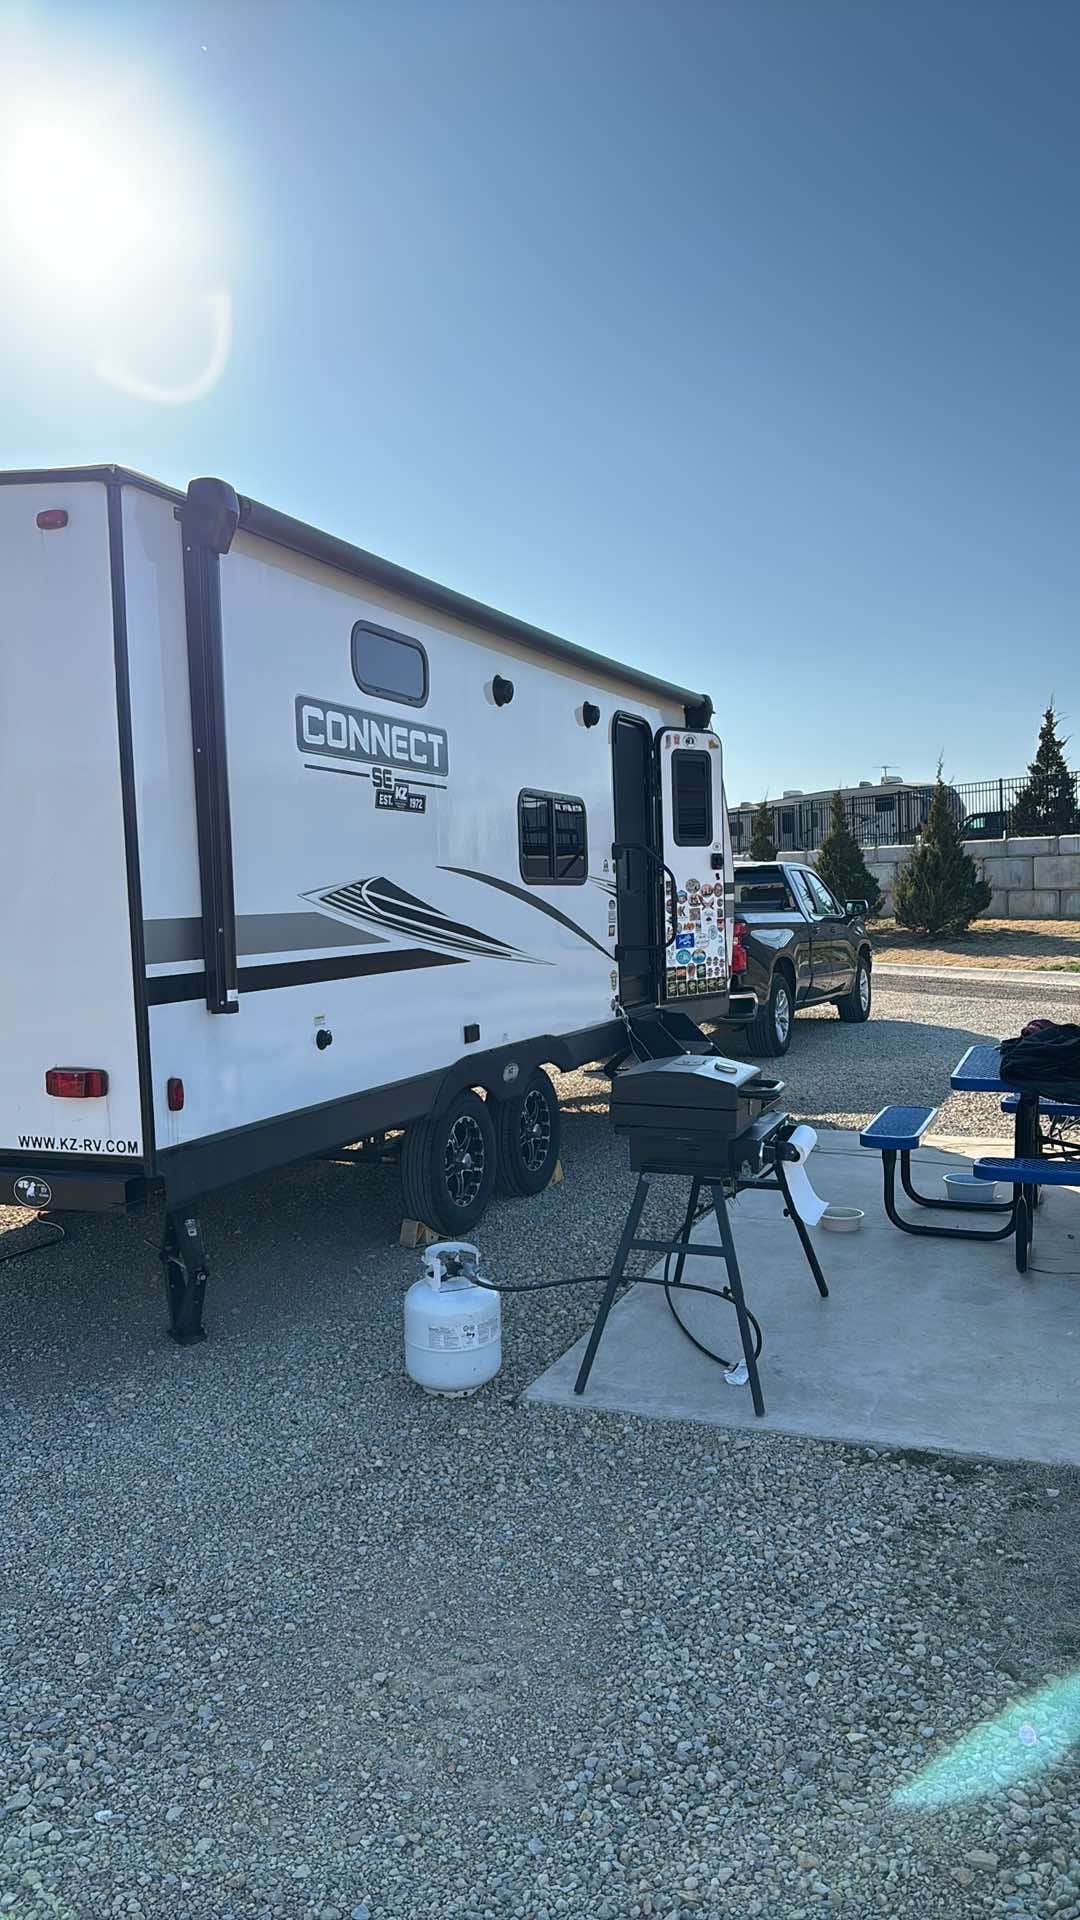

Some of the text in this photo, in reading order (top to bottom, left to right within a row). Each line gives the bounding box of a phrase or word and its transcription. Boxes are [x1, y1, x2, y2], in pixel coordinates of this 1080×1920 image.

[302, 705, 443, 768] CONNECT
[372, 767, 393, 789] SE
[379, 794, 393, 806] EST.
[409, 797, 423, 809] 1972
[395, 786, 408, 800] KZ
[18, 1135, 139, 1154] WWW.KZ-RV.COM
